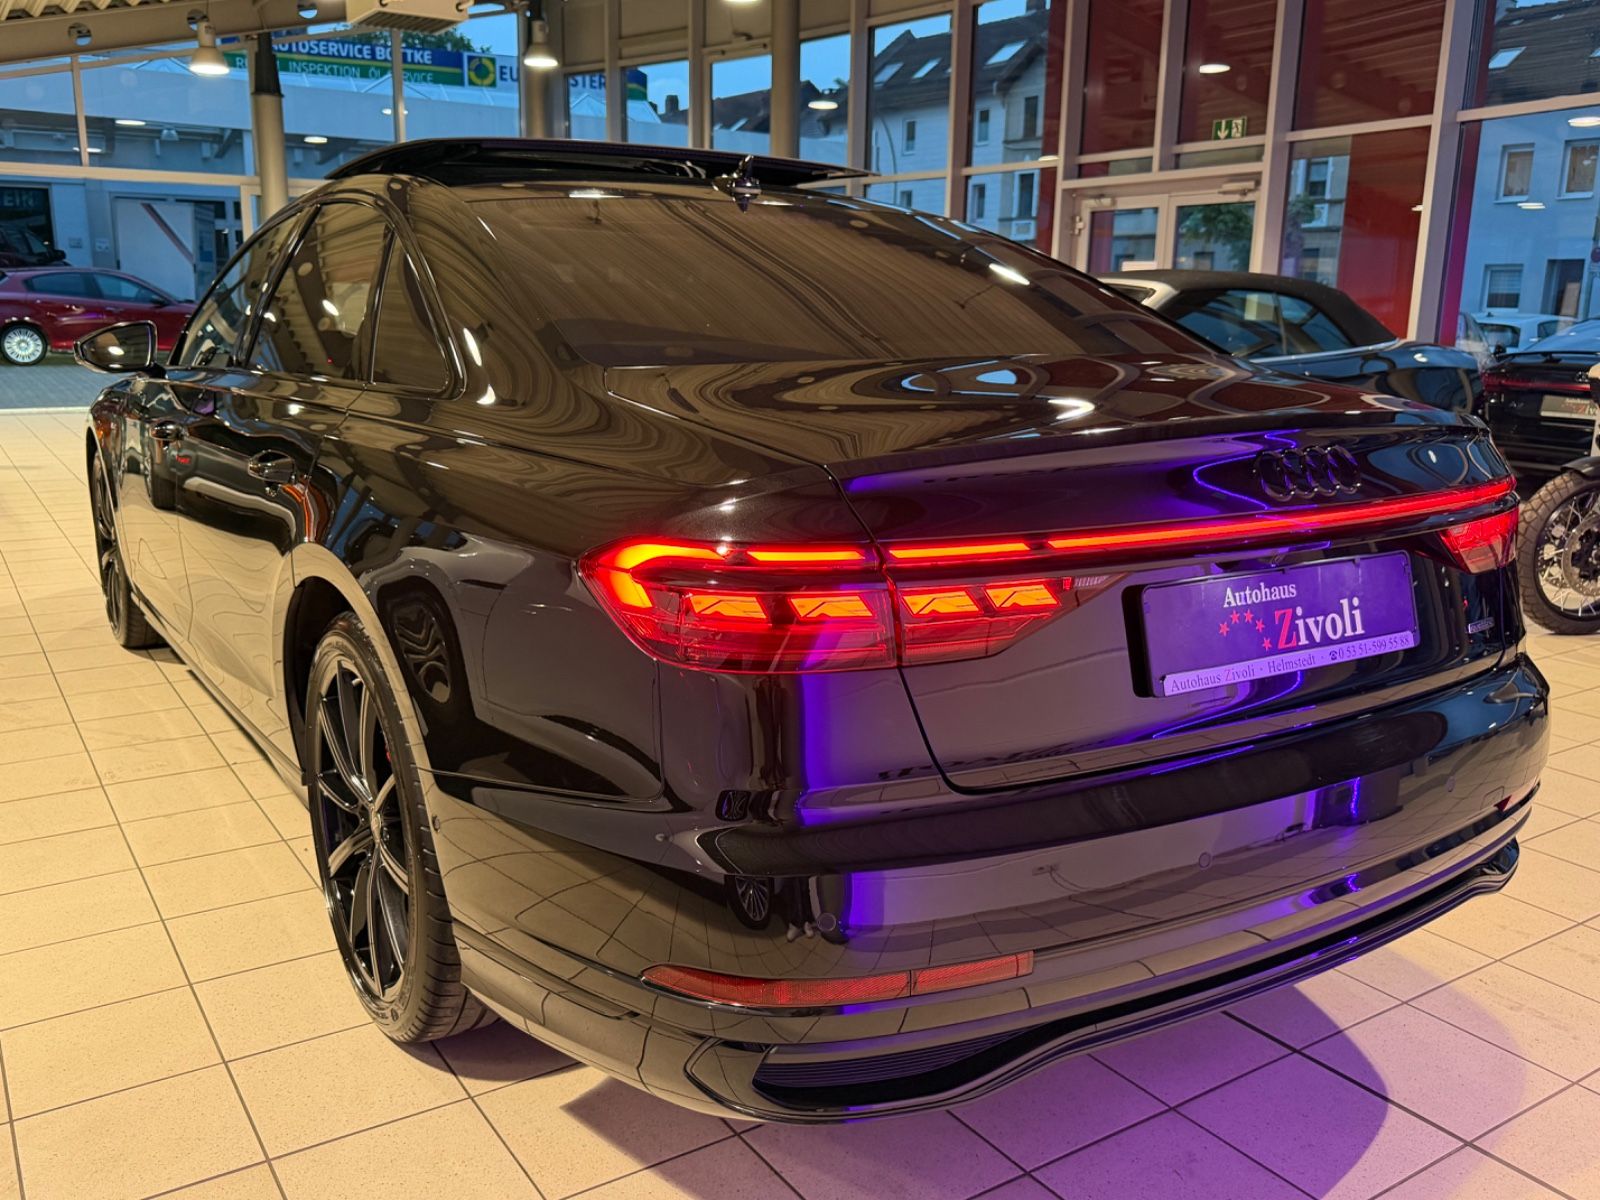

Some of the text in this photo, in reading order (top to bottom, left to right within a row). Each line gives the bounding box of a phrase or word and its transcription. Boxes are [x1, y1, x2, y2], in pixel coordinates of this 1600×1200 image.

[272, 40, 371, 60] UTOSERVICE
[289, 60, 360, 78] INSPEKTION
[1223, 581, 1297, 608] Autohaus
[1274, 596, 1366, 650] Zivoli
[1171, 673, 1221, 692] Autohaus
[1224, 664, 1255, 681] Zivoli
[1267, 654, 1315, 673] Helmstedt
